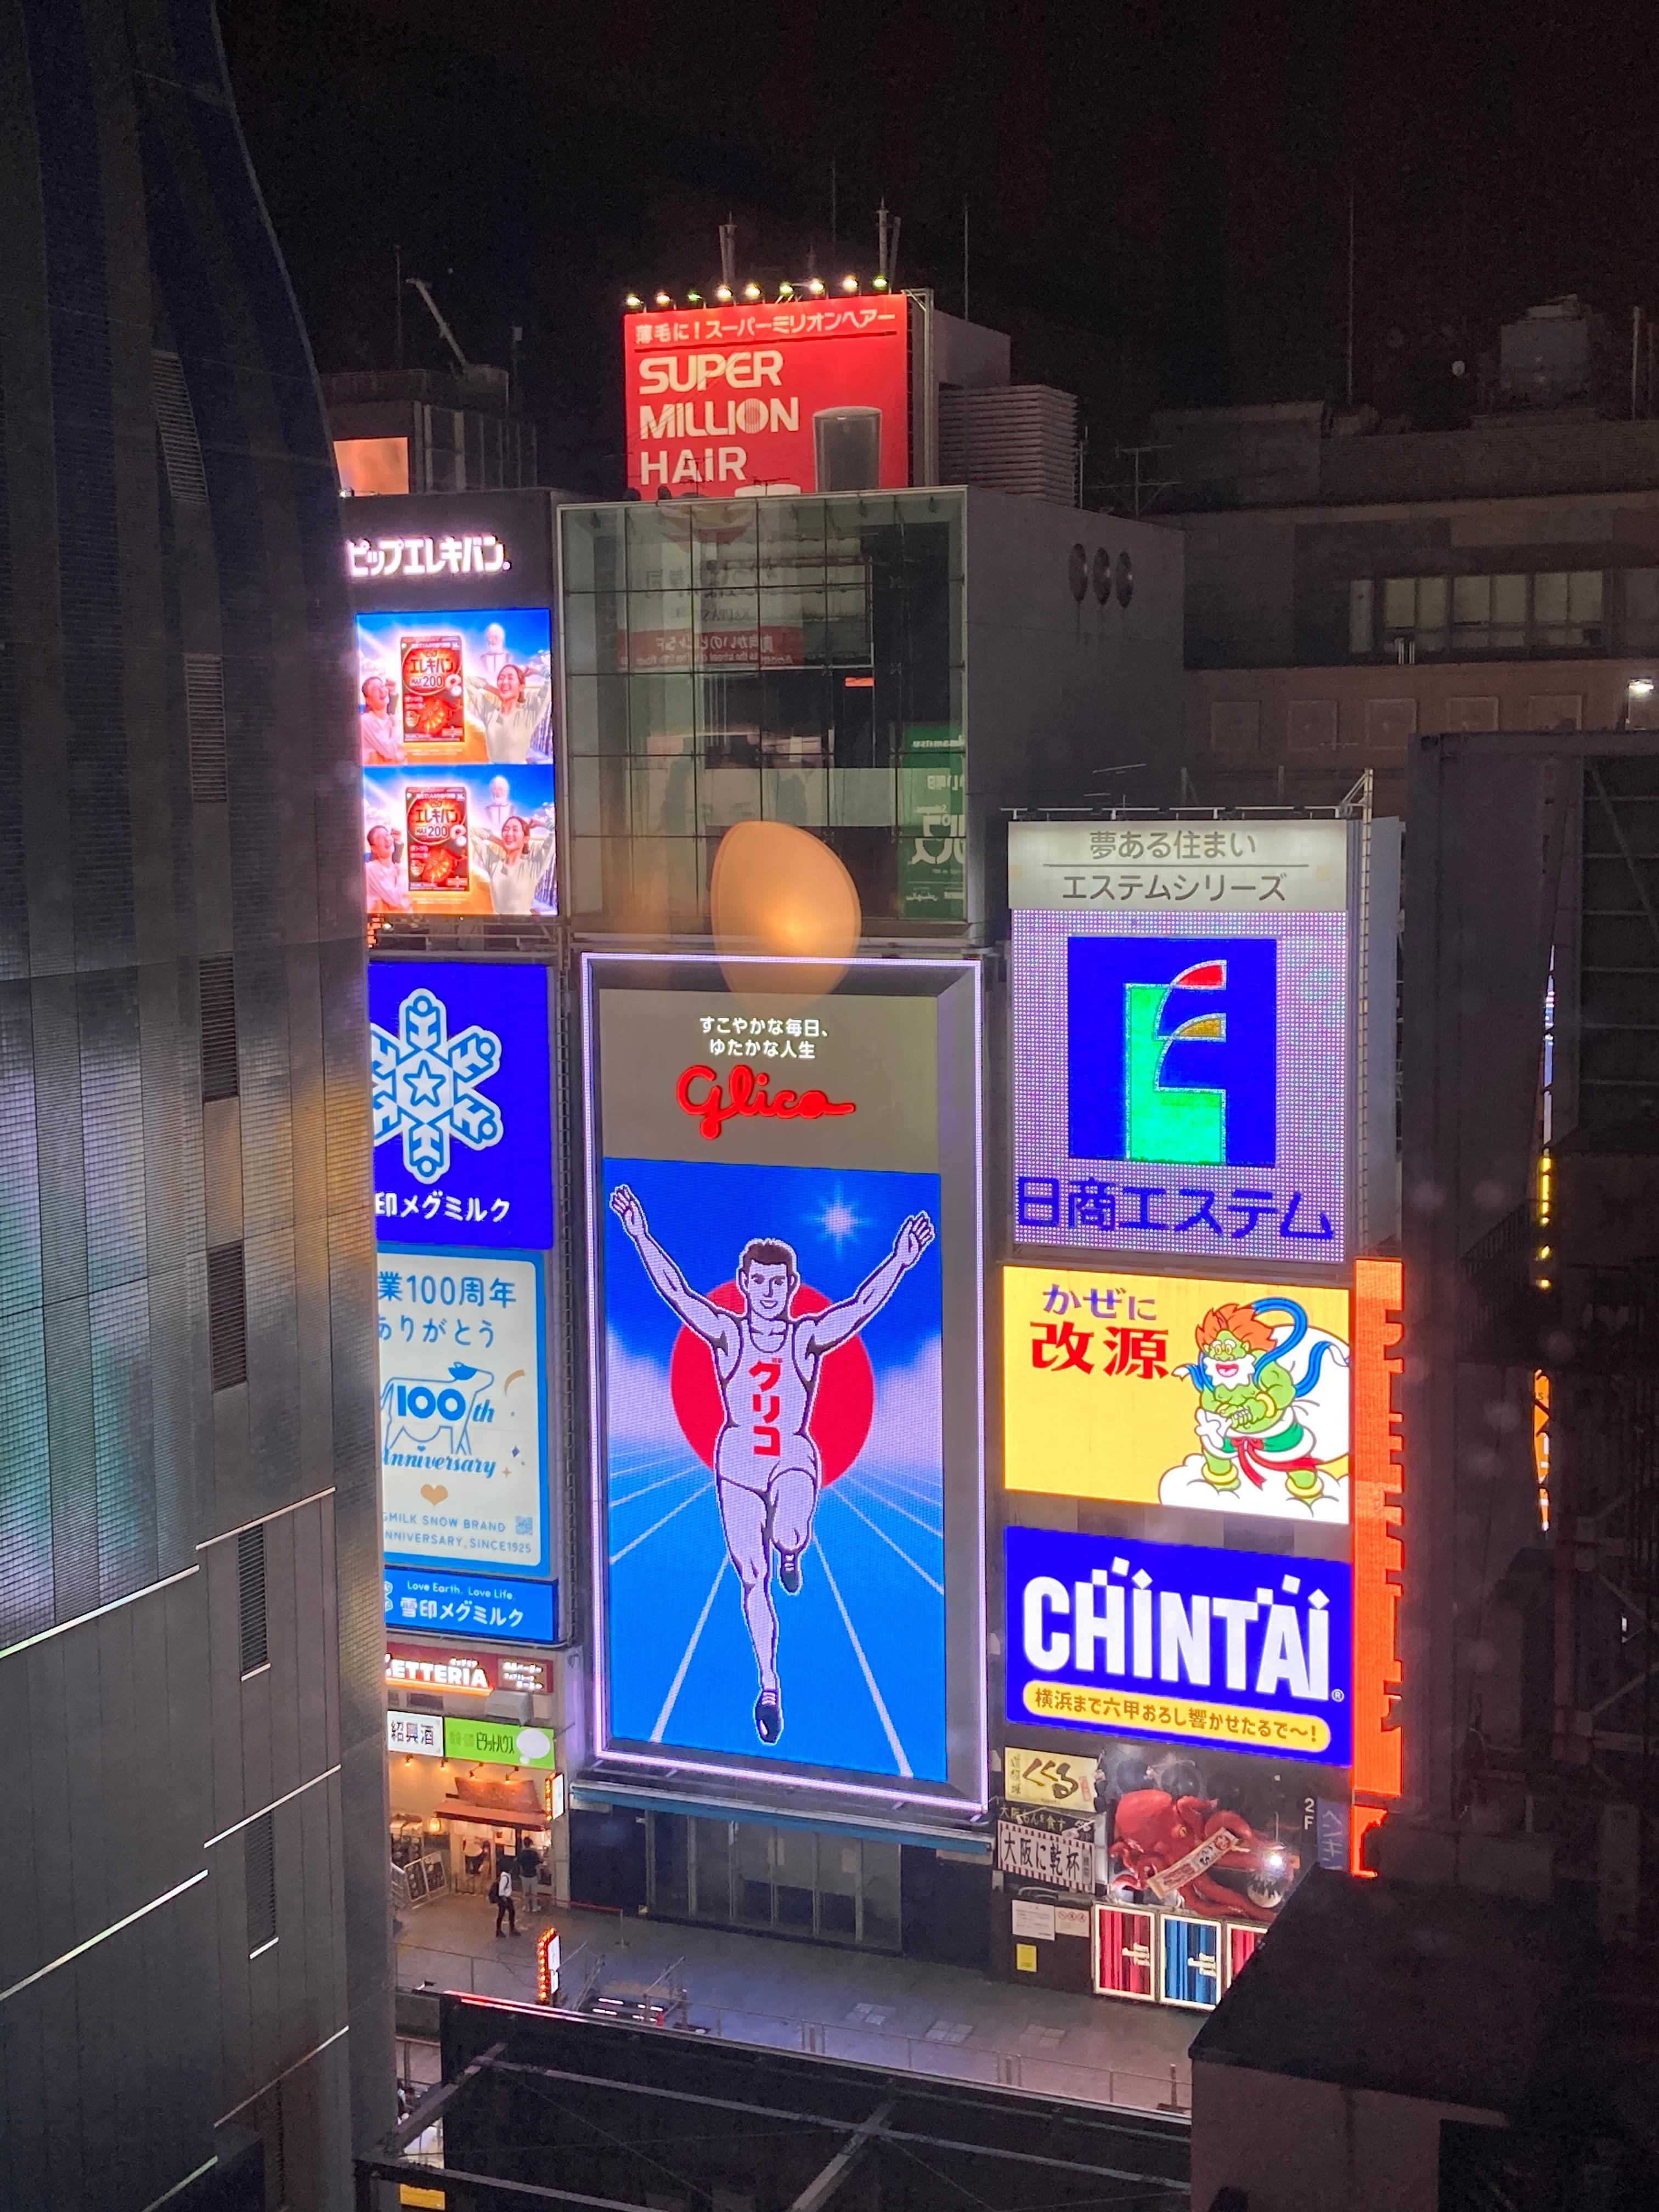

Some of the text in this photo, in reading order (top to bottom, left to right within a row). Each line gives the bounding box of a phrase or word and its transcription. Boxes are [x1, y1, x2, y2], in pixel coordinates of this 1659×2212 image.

[639, 350, 783, 394] SUPER
[640, 397, 799, 439] MILLION
[641, 446, 747, 485] HAIR
[410, 658, 453, 674] エレキバン
[416, 808, 458, 823] エレキバン
[1090, 831, 1256, 859] 夢ある住まい
[1063, 873, 1288, 902] エステムシリーズ
[700, 1016, 828, 1037] すこやかな毎日、
[710, 1039, 815, 1059] ゆたかな人生
[677, 1064, 856, 1139] Glico
[1018, 1176, 1333, 1240] 日商エステム
[1043, 1284, 1156, 1321] かぜに
[1030, 1321, 1170, 1380] 改源
[749, 1357, 783, 1457] グリコ
[422, 1515, 458, 1527] SNOW
[464, 1519, 506, 1532] BRAND
[407, 1581, 430, 1591] Love
[469, 1586, 491, 1598] Love
[400, 1597, 524, 1628] 雪印メグミルク
[1023, 1556, 1330, 1701] CHINTAI
[385, 1653, 489, 1689] ETTERIA
[1023, 1758, 1079, 1799] くくる
[1004, 1832, 1081, 1881] 大阪に乾杯
